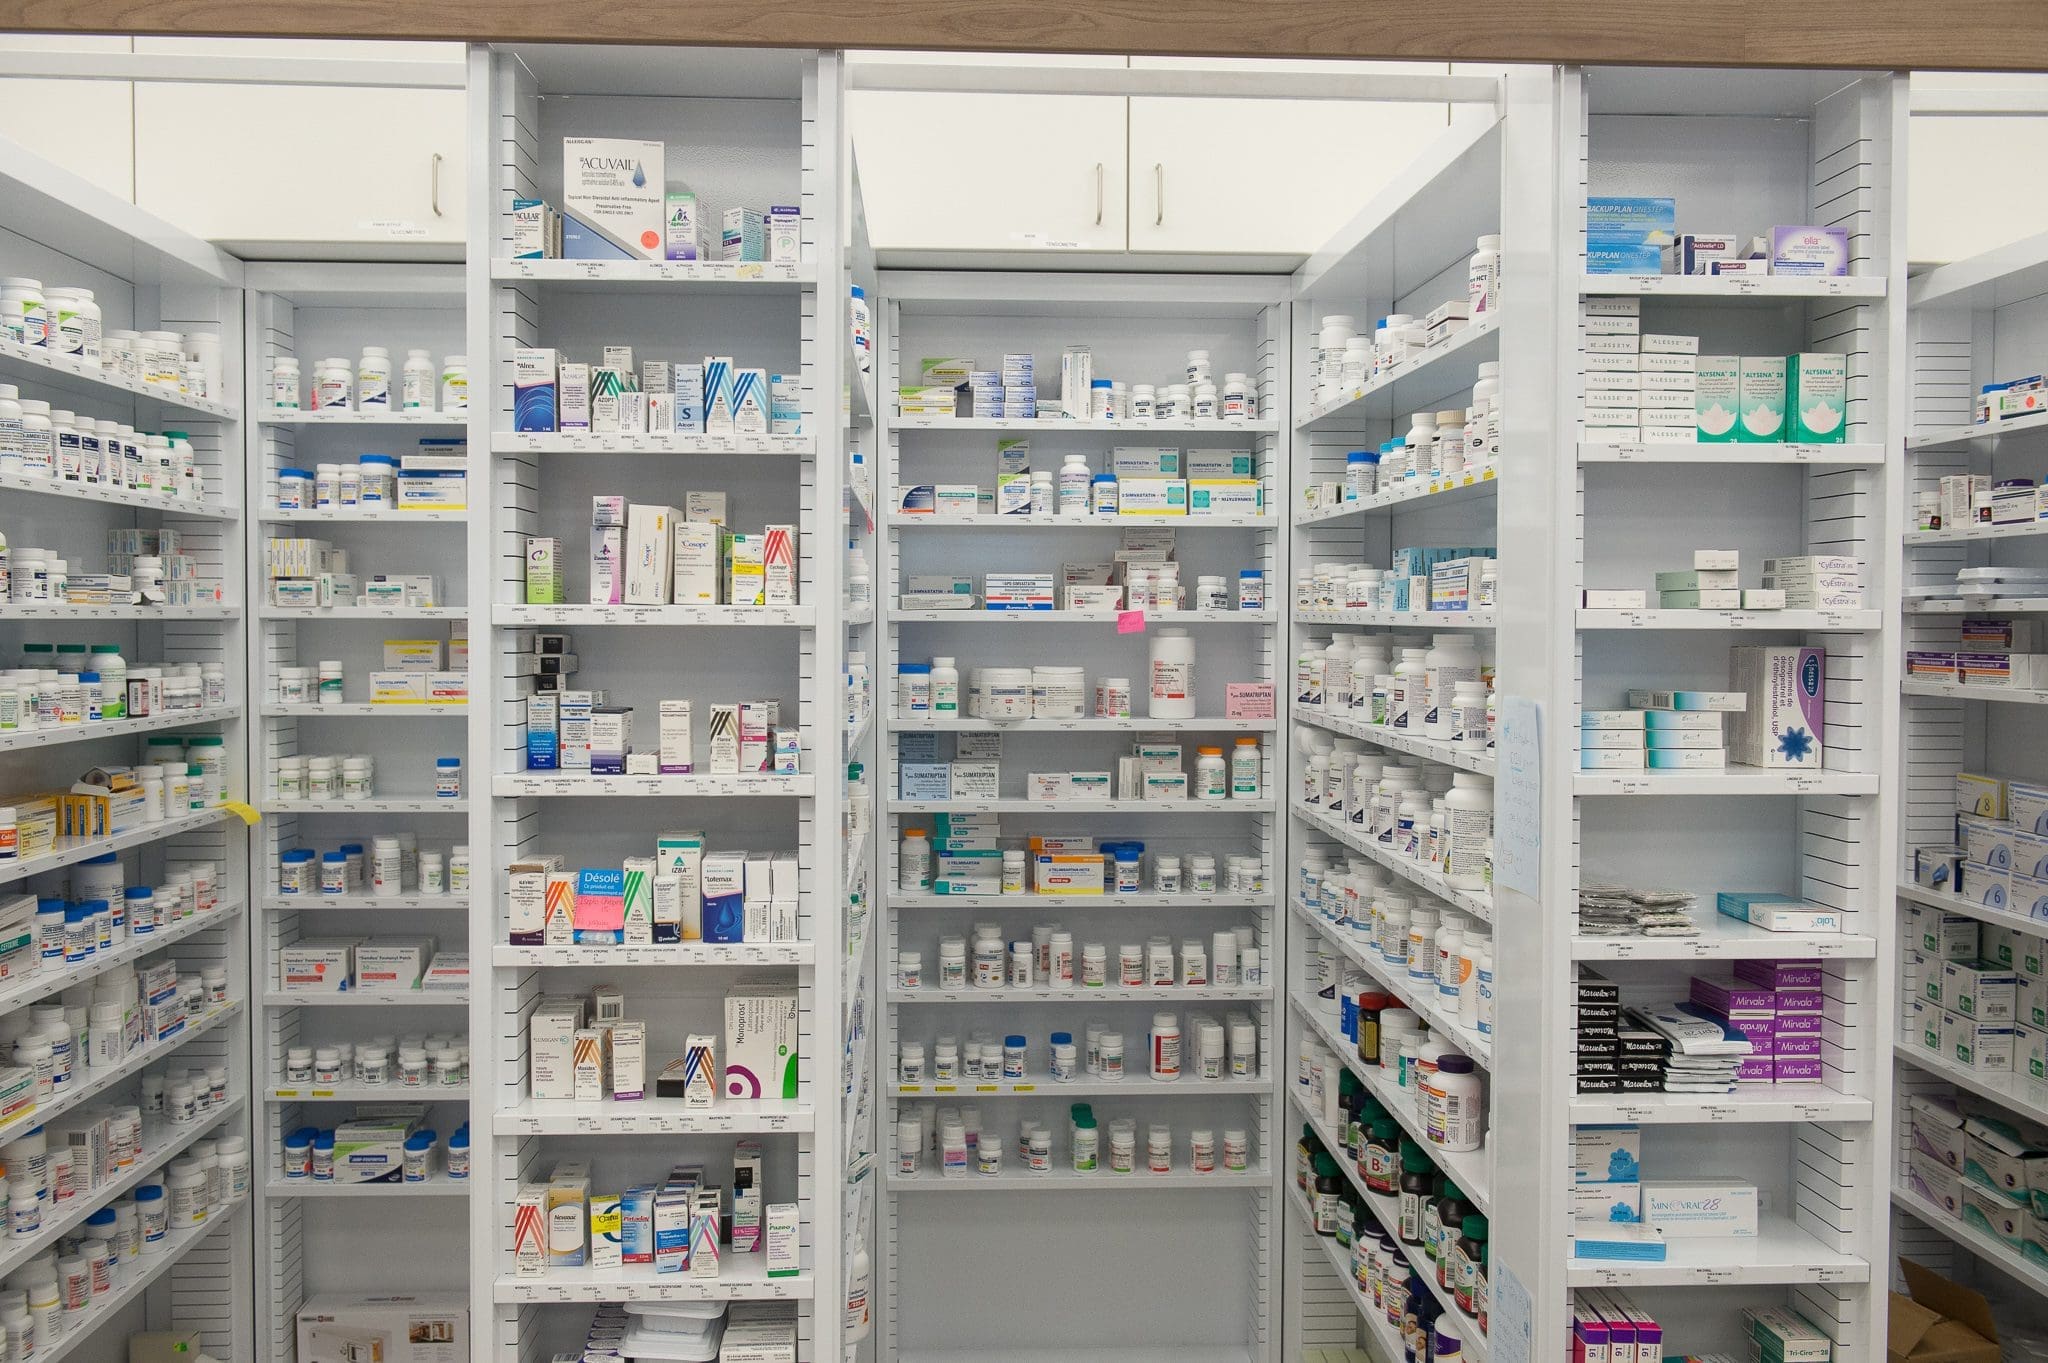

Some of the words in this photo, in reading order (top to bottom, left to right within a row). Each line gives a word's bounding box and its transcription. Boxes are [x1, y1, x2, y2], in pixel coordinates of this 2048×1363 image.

[583, 156, 634, 171] ACUVAIL
[1804, 236, 1820, 246] ella
[1745, 371, 1773, 379] ALYSENA
[682, 407, 692, 420] S
[682, 540, 708, 548] Cosopt
[1788, 655, 1796, 700] Comprimés
[1984, 799, 1990, 812] 8
[1999, 850, 2006, 864] 6
[584, 872, 620, 883] Désolé
[1994, 890, 2001, 904] 6
[1781, 973, 1811, 984] Mirvala
[1579, 989, 1609, 997] Marvelon
[1735, 996, 1766, 1006] Mirvala
[1783, 995, 1814, 1007] Mirvala
[1579, 1008, 1609, 1016] Marvelon
[736, 1003, 746, 1044] Monoprost
[1739, 1022, 1769, 1034] Mirvala
[1781, 1018, 1812, 1030] Mirvala
[1579, 1043, 1608, 1052] Marvelon
[1625, 1042, 1655, 1050] Marvelon
[1781, 1041, 1811, 1052] Mirvala
[1735, 1064, 1763, 1075] Mirvala
[1782, 1064, 1813, 1075] Mirvala
[1579, 1080, 1609, 1089] Marvelon
[1624, 1079, 1653, 1089] Marvelon
[1703, 1198, 1721, 1211] 28
[1589, 1347, 1597, 1358] 91
[1615, 1347, 1624, 1357] 91
[1641, 1347, 1650, 1358] 91
